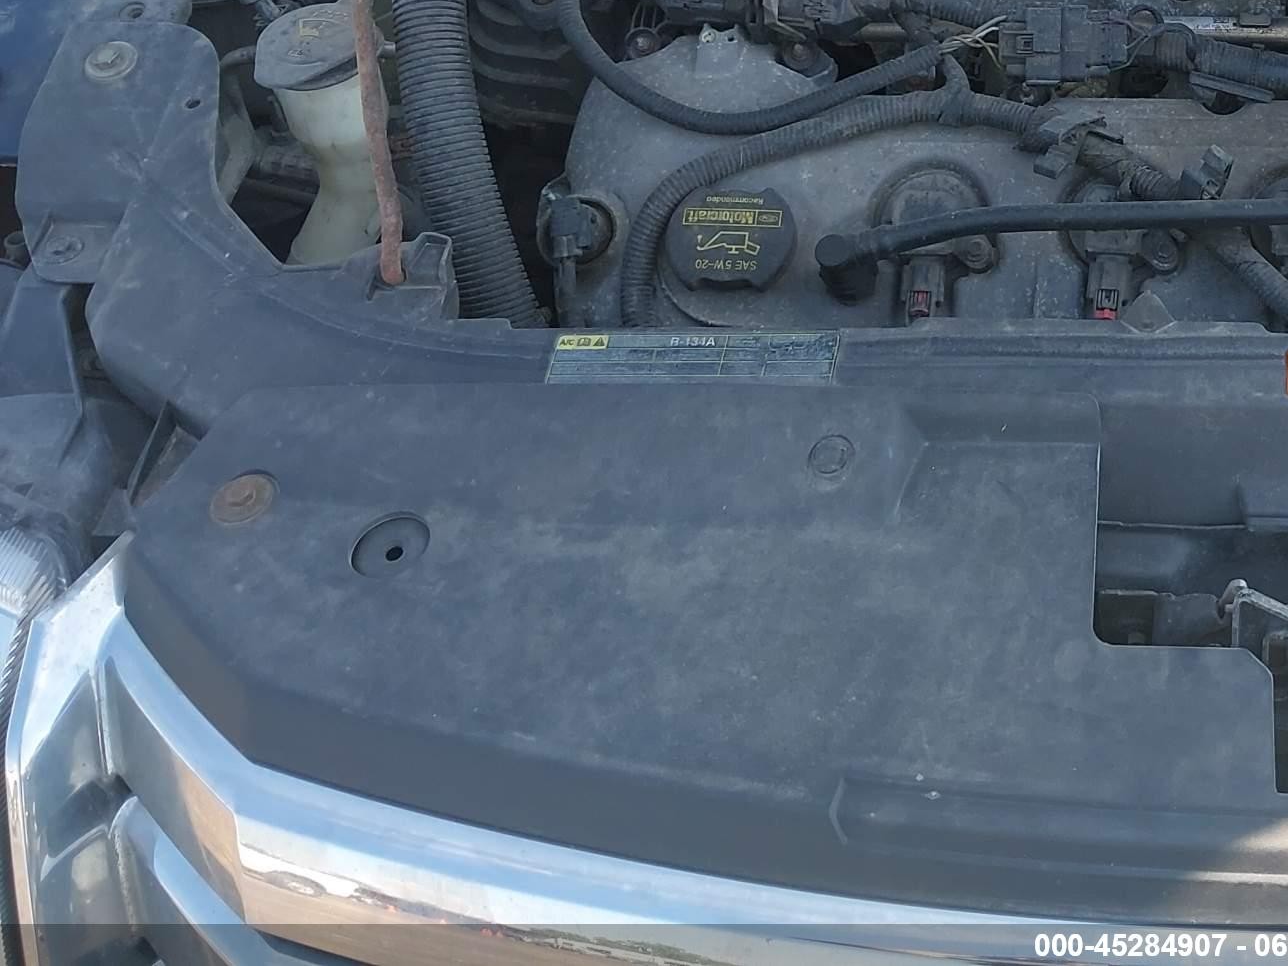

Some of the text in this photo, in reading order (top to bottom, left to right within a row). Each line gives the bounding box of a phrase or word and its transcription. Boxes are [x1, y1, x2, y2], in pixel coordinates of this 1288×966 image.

[687, 209, 755, 224] Motorcraft
[695, 259, 758, 271] SAE 5W-20
[559, 337, 574, 347] A/C
